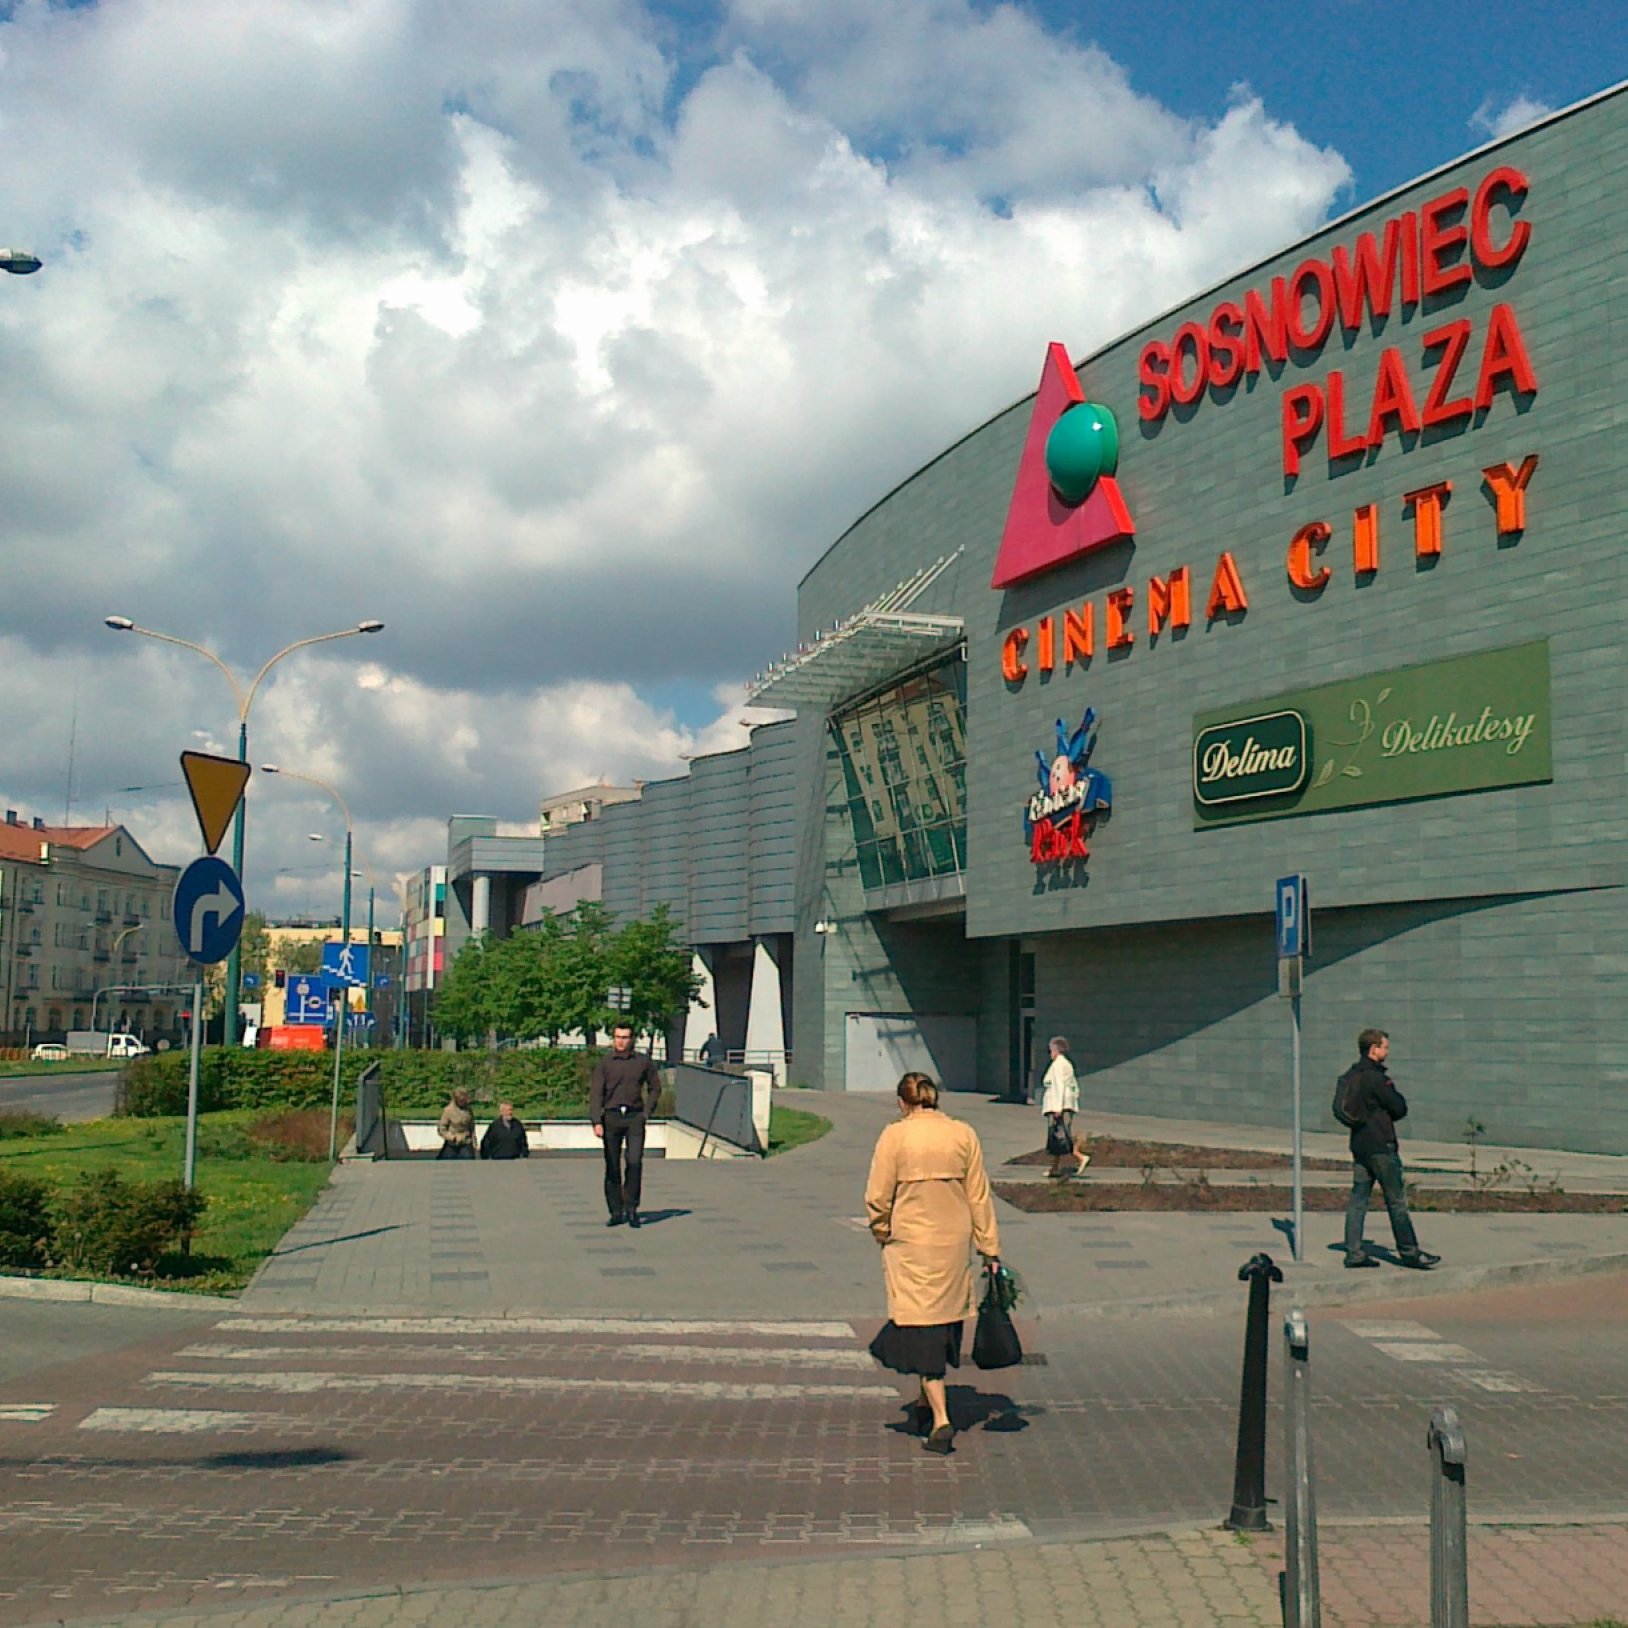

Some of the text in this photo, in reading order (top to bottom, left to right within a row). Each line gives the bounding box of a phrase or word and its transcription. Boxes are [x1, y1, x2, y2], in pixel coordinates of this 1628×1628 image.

[1138, 166, 1531, 422] SOSNOWIEC
[1282, 303, 1537, 476] PLAZA
[1002, 454, 1539, 682] CINEMA CITY
[1200, 736, 1296, 782] Delima
[1380, 706, 1536, 755] Delikatesy
[1281, 885, 1295, 946] P
